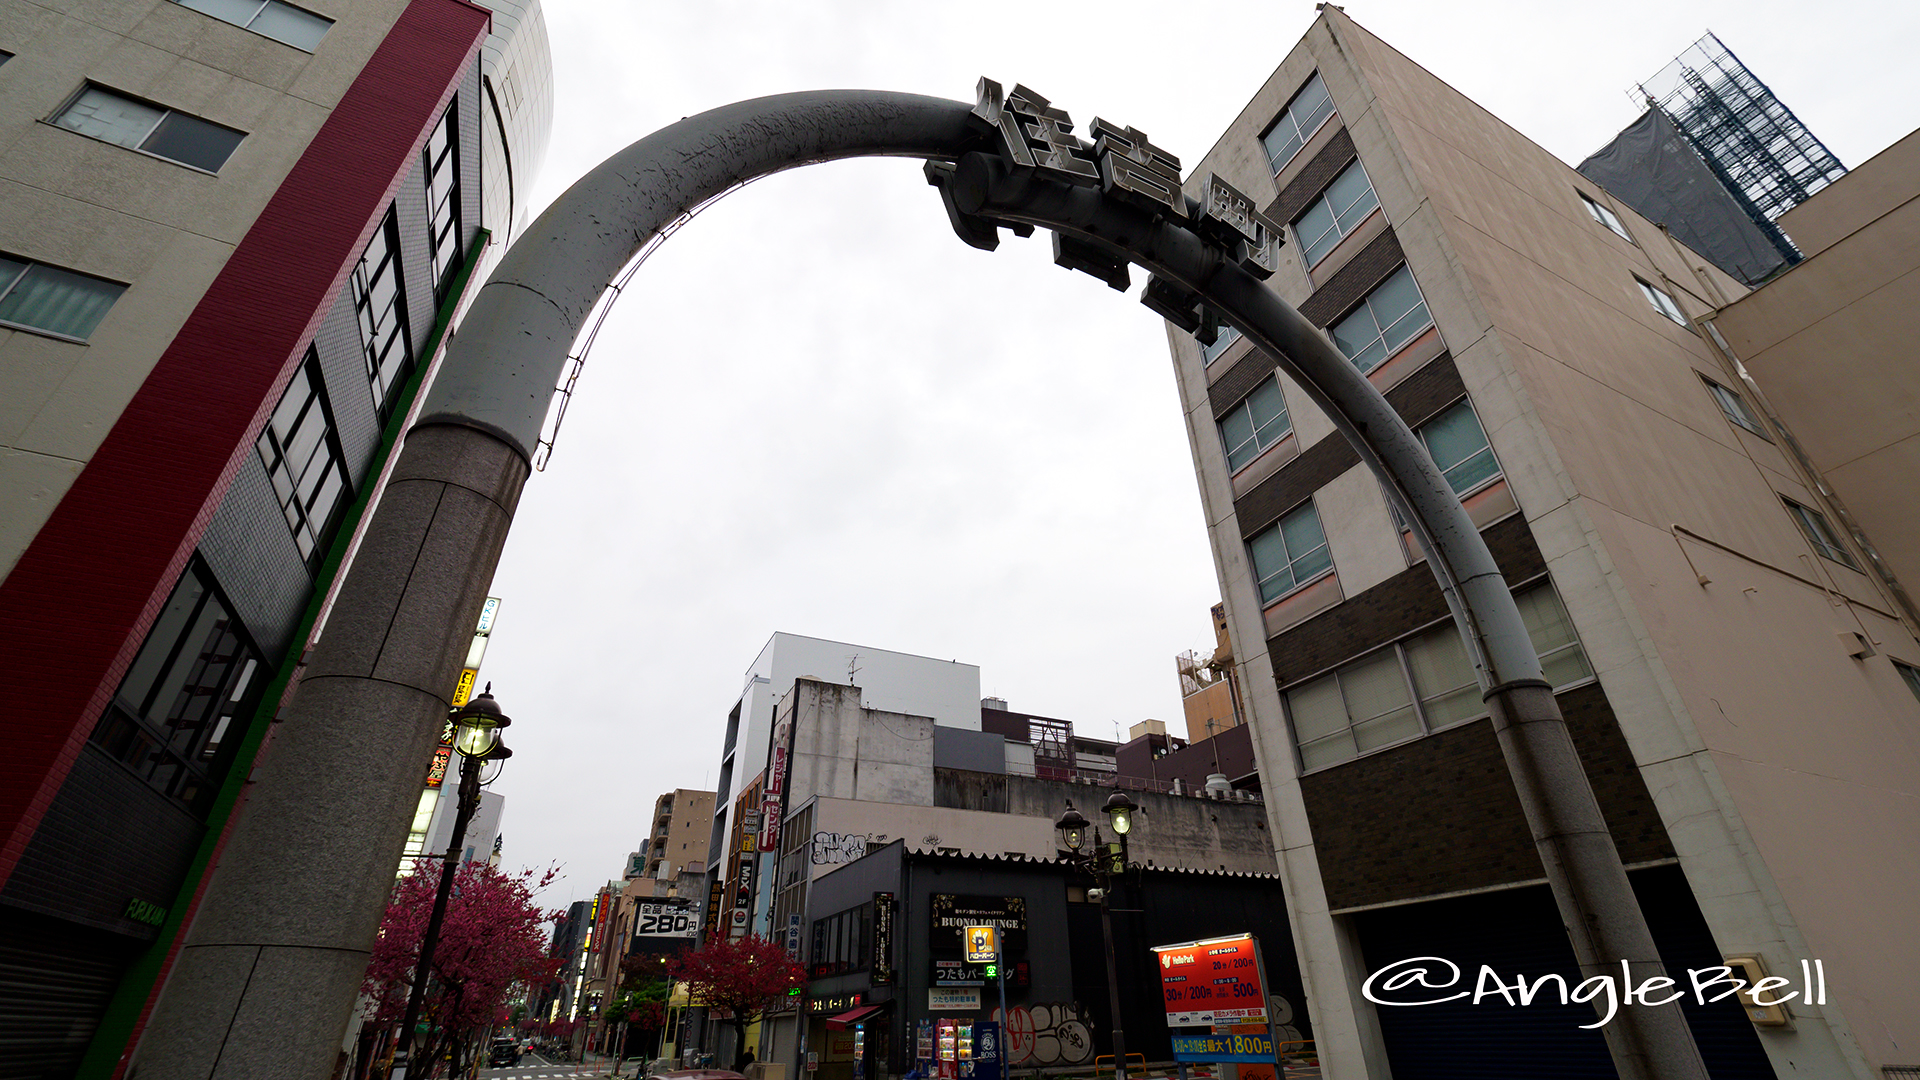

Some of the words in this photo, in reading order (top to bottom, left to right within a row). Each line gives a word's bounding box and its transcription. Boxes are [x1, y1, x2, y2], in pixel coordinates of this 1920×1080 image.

[971, 76, 1286, 281] 住吉町
[775, 753, 784, 792] レジャー
[769, 804, 779, 845] センター
[640, 914, 697, 934] 280円
[941, 916, 978, 928] BUONO
[979, 918, 1019, 930] LOUNGE
[986, 965, 997, 977] 空
[980, 1050, 997, 1059] BOSS
